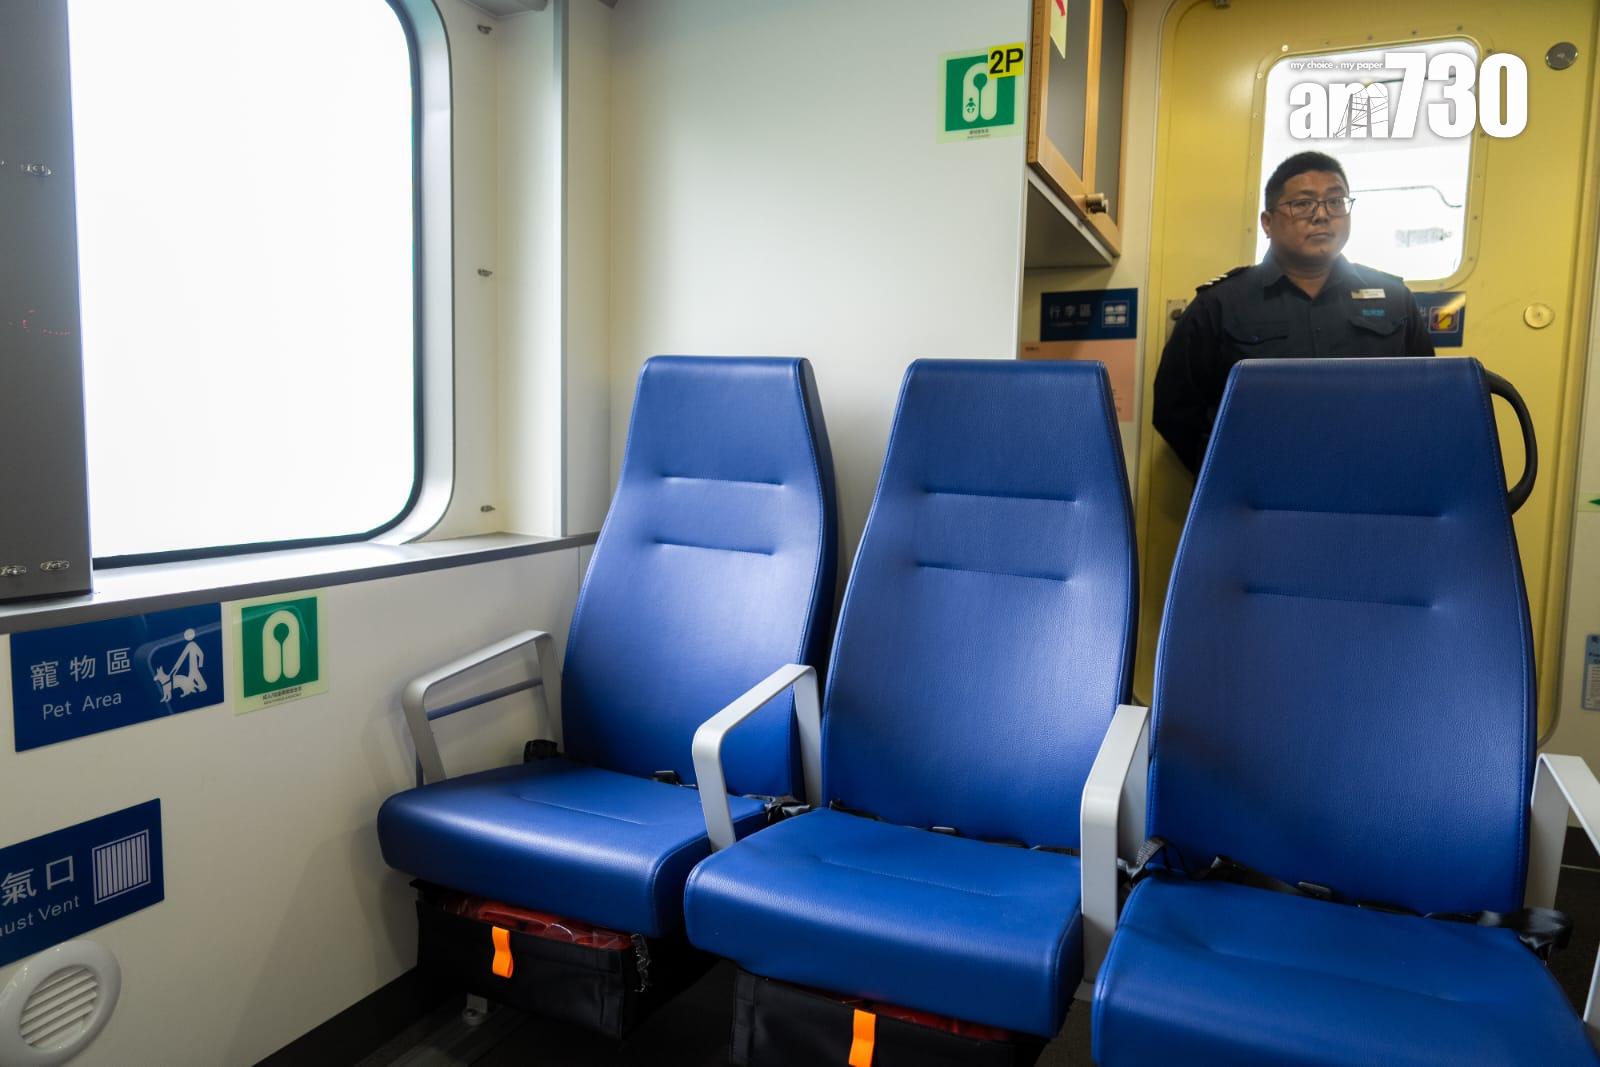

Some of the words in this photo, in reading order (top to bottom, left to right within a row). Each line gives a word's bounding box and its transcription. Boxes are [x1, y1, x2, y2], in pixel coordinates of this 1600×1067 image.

[989, 47, 1024, 75] 2P
[30, 647, 132, 691] 寵物區
[42, 700, 72, 720] Pet
[82, 692, 122, 712] Area
[0, 855, 74, 906] 氣口
[0, 912, 34, 937] ust
[38, 895, 80, 921] Vent
